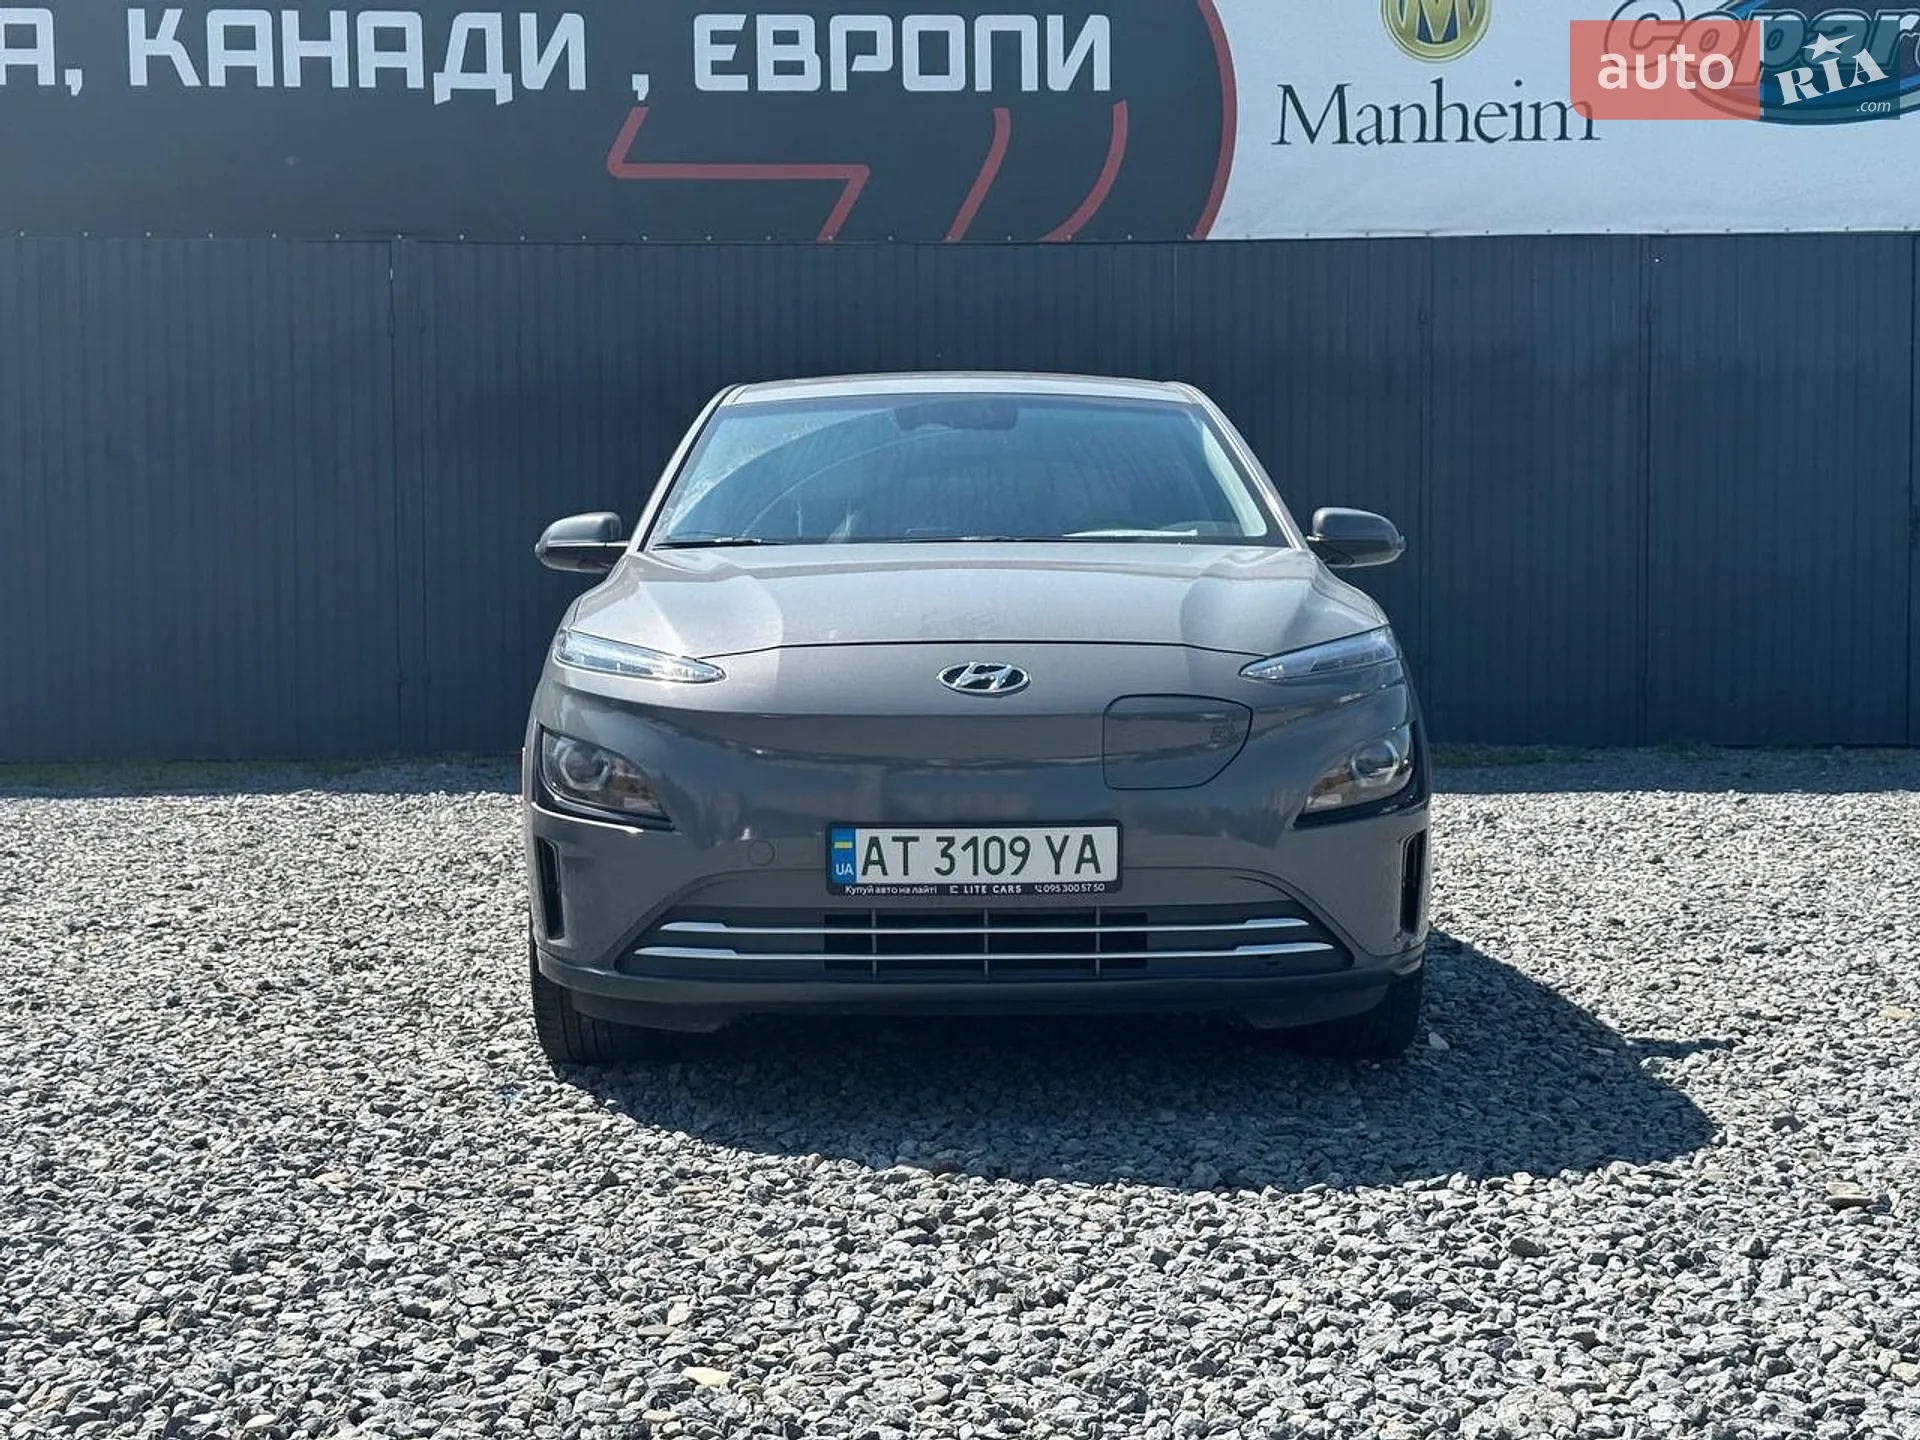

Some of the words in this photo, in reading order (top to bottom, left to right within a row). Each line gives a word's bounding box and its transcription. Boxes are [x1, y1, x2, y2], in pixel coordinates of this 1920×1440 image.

[127, 8, 587, 105] КАНАДИ
[694, 14, 1111, 91] ЕВРОПИ
[1604, 0, 1920, 84] Copar
[1271, 78, 1603, 147] Manheim
[834, 864, 854, 876] UA
[861, 835, 920, 876] AT
[933, 835, 1032, 876] 3109
[1044, 834, 1102, 875] YA
[964, 885, 987, 893] LITE
[992, 884, 1022, 893] CARS
